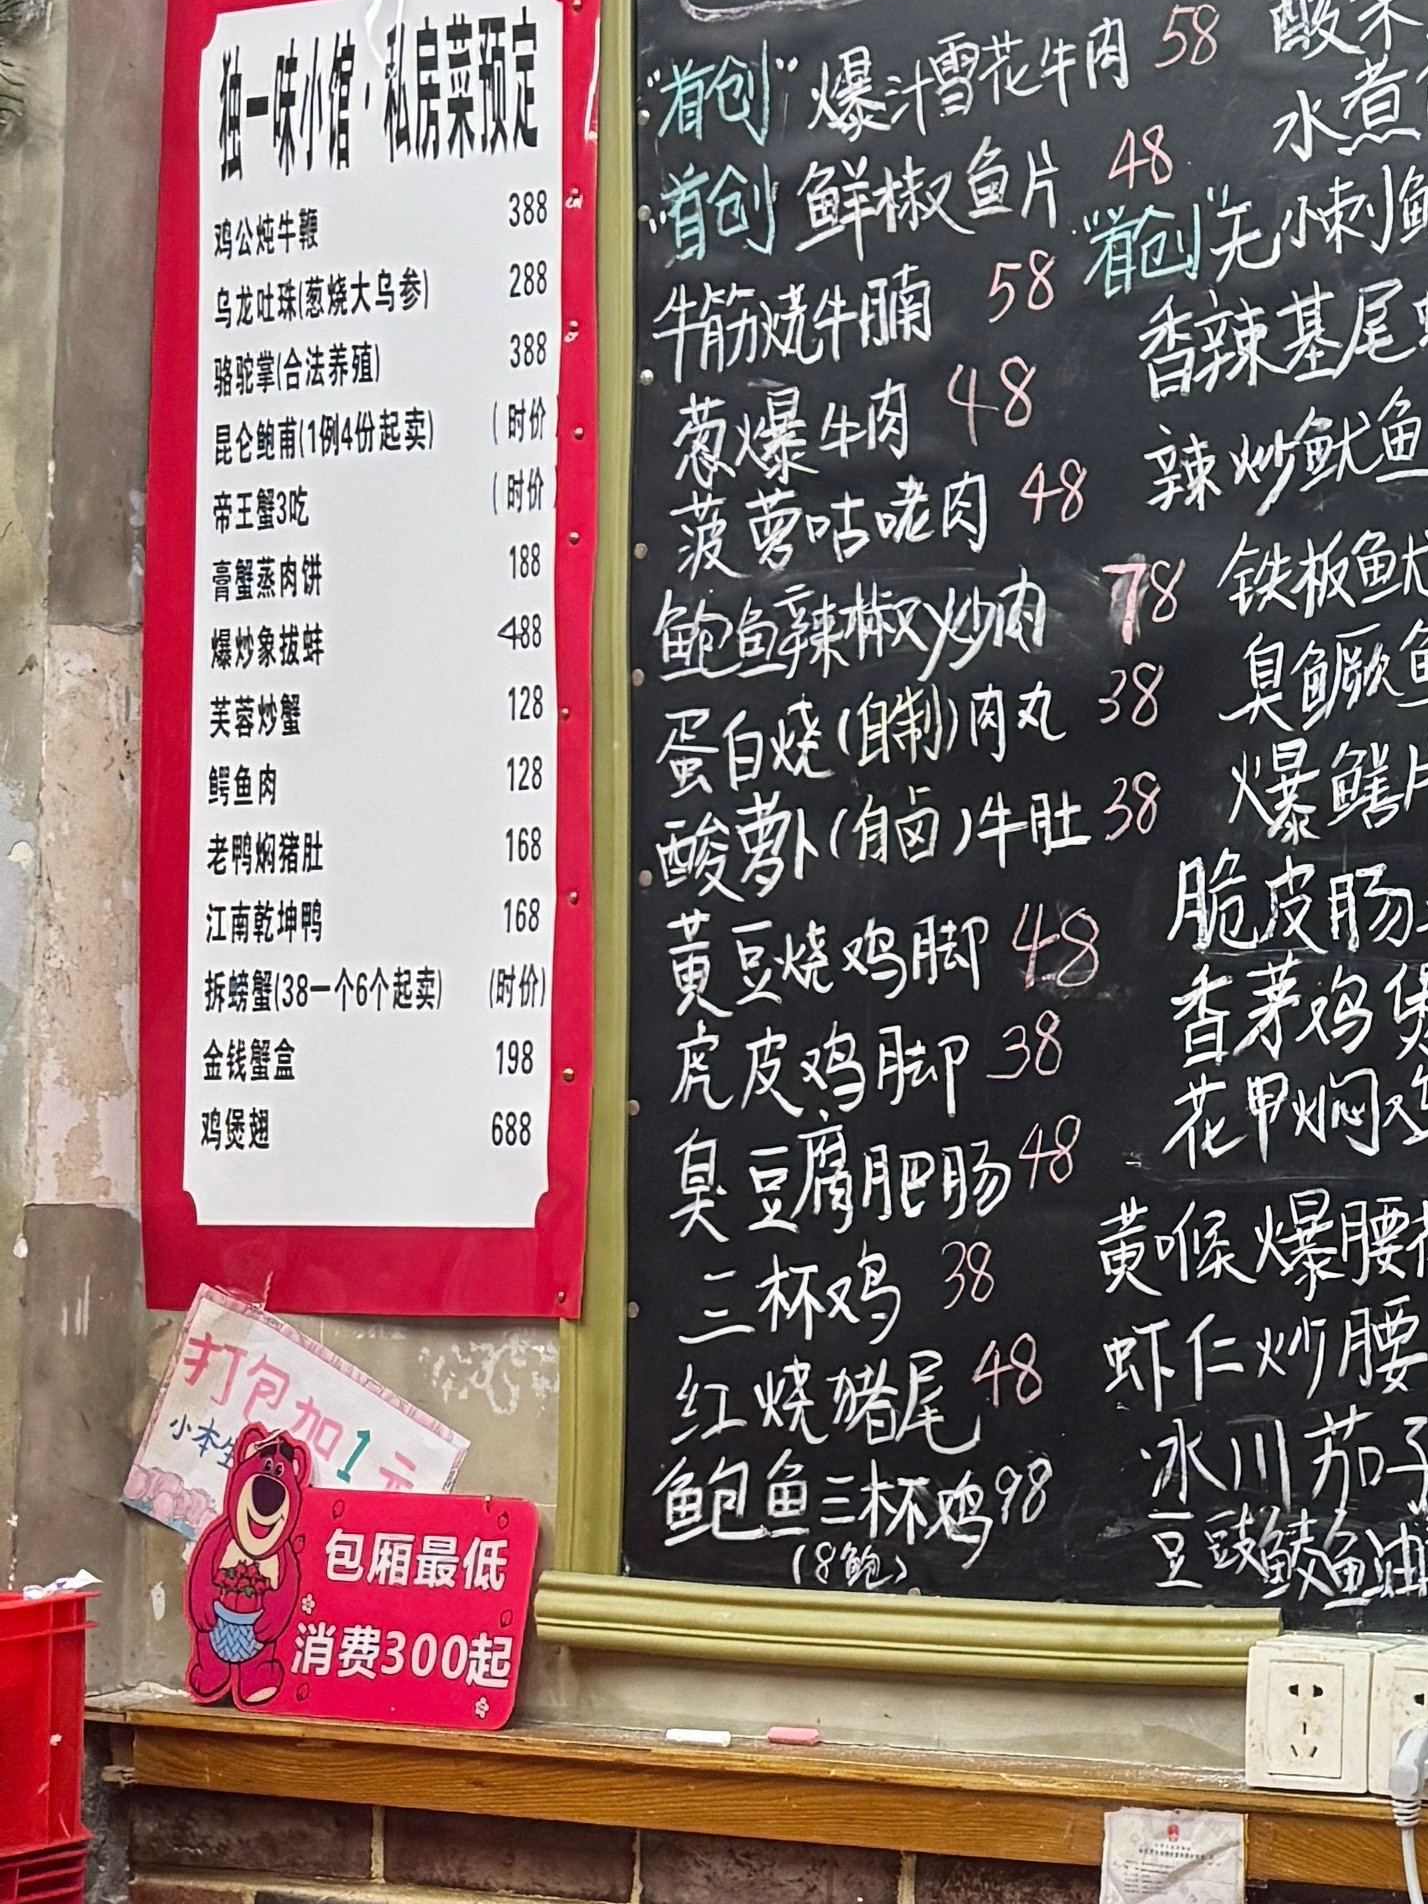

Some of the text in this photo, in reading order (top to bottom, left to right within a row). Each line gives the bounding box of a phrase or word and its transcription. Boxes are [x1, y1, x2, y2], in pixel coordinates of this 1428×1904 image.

[1154, 4, 1219, 68] 58
[508, 191, 548, 227] 388
[796, 124, 1173, 260] 鲜椒鱼片 48
[509, 262, 547, 298] 288
[988, 249, 1055, 323] 58
[214, 331, 547, 397] 骆驼掌(合法养殖) 388
[671, 355, 1037, 489] 葱爆牛肉 48
[214, 484, 309, 534] 帝王蟹3吃
[1019, 458, 1087, 524] 48
[212, 544, 541, 604] 膏蟹蒸肉饼 188
[211, 623, 324, 670] 爆炒象拔蚌
[653, 557, 1185, 682] 鲍鱼辣椒炒肉 78
[209, 685, 543, 738] 芙蓉炒蟹 128
[1099, 662, 1163, 727] 38
[207, 756, 543, 808] 鳄鱼肉 128
[1102, 771, 1162, 841] 38
[206, 826, 541, 876] 老鸭焖猪肚 168
[205, 898, 540, 944] 江南乾坤鸭 168
[667, 901, 1100, 1017] 黄豆烧鸡脚 48
[203, 1037, 533, 1083] 金钱蟹盒 198
[671, 1008, 1062, 1117] 虎皮鸡脚 38
[200, 1107, 532, 1152] 鸡煲翅 688
[670, 1109, 1081, 1243] 臭豆腐肥肠 48
[679, 1239, 994, 1344] 三杯鸡 38
[670, 1332, 1042, 1454] 红烧猪尾 48
[653, 1448, 1053, 1569] 鲍鱼三杯鸡 98
[325, 1529, 509, 1592] 包厢最低
[290, 1622, 514, 1688] 消费300起
